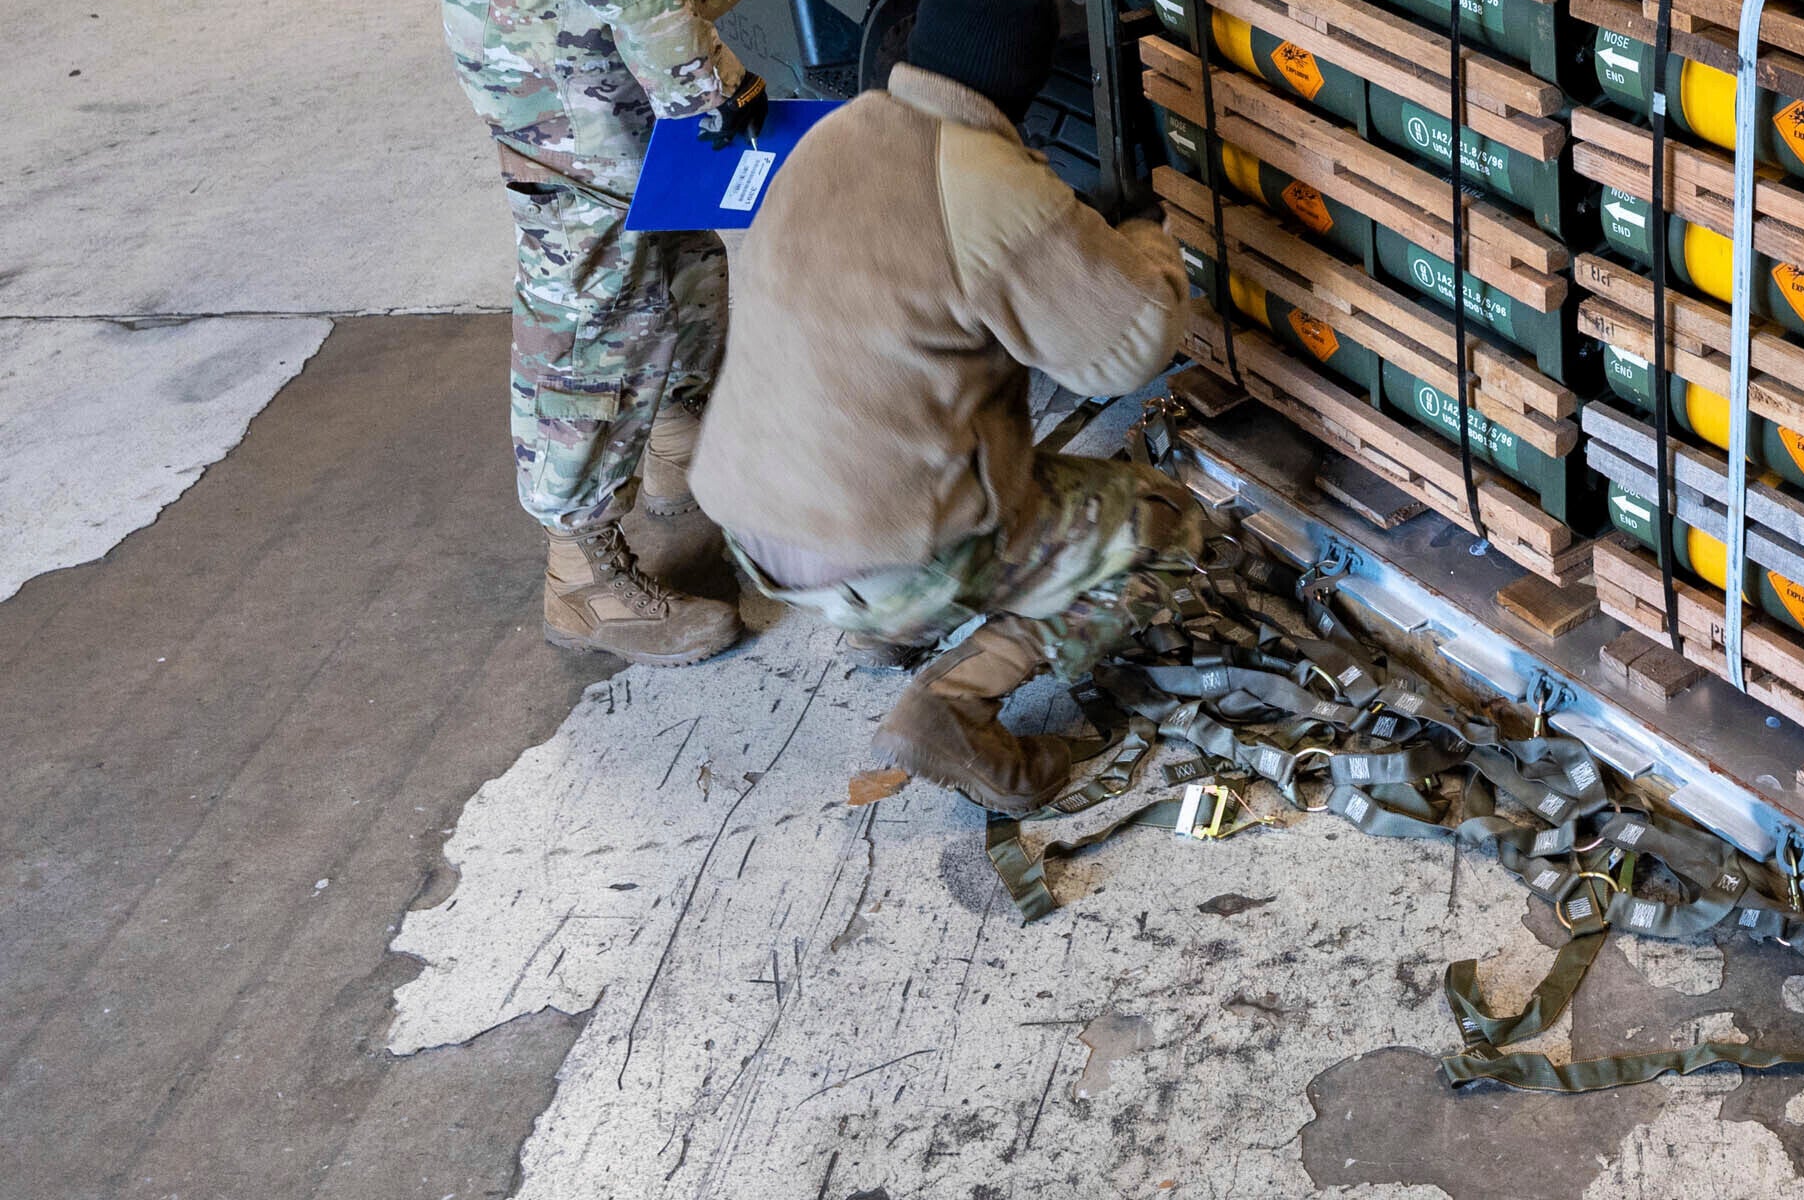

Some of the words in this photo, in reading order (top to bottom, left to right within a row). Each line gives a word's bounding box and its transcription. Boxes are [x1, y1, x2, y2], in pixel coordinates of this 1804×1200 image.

[1603, 30, 1630, 49] NOSE
[1605, 69, 1625, 85] END
[1431, 142, 1452, 163] USA/
[1612, 222, 1631, 238] END
[1614, 361, 1633, 380] END
[1619, 512, 1638, 530] END
